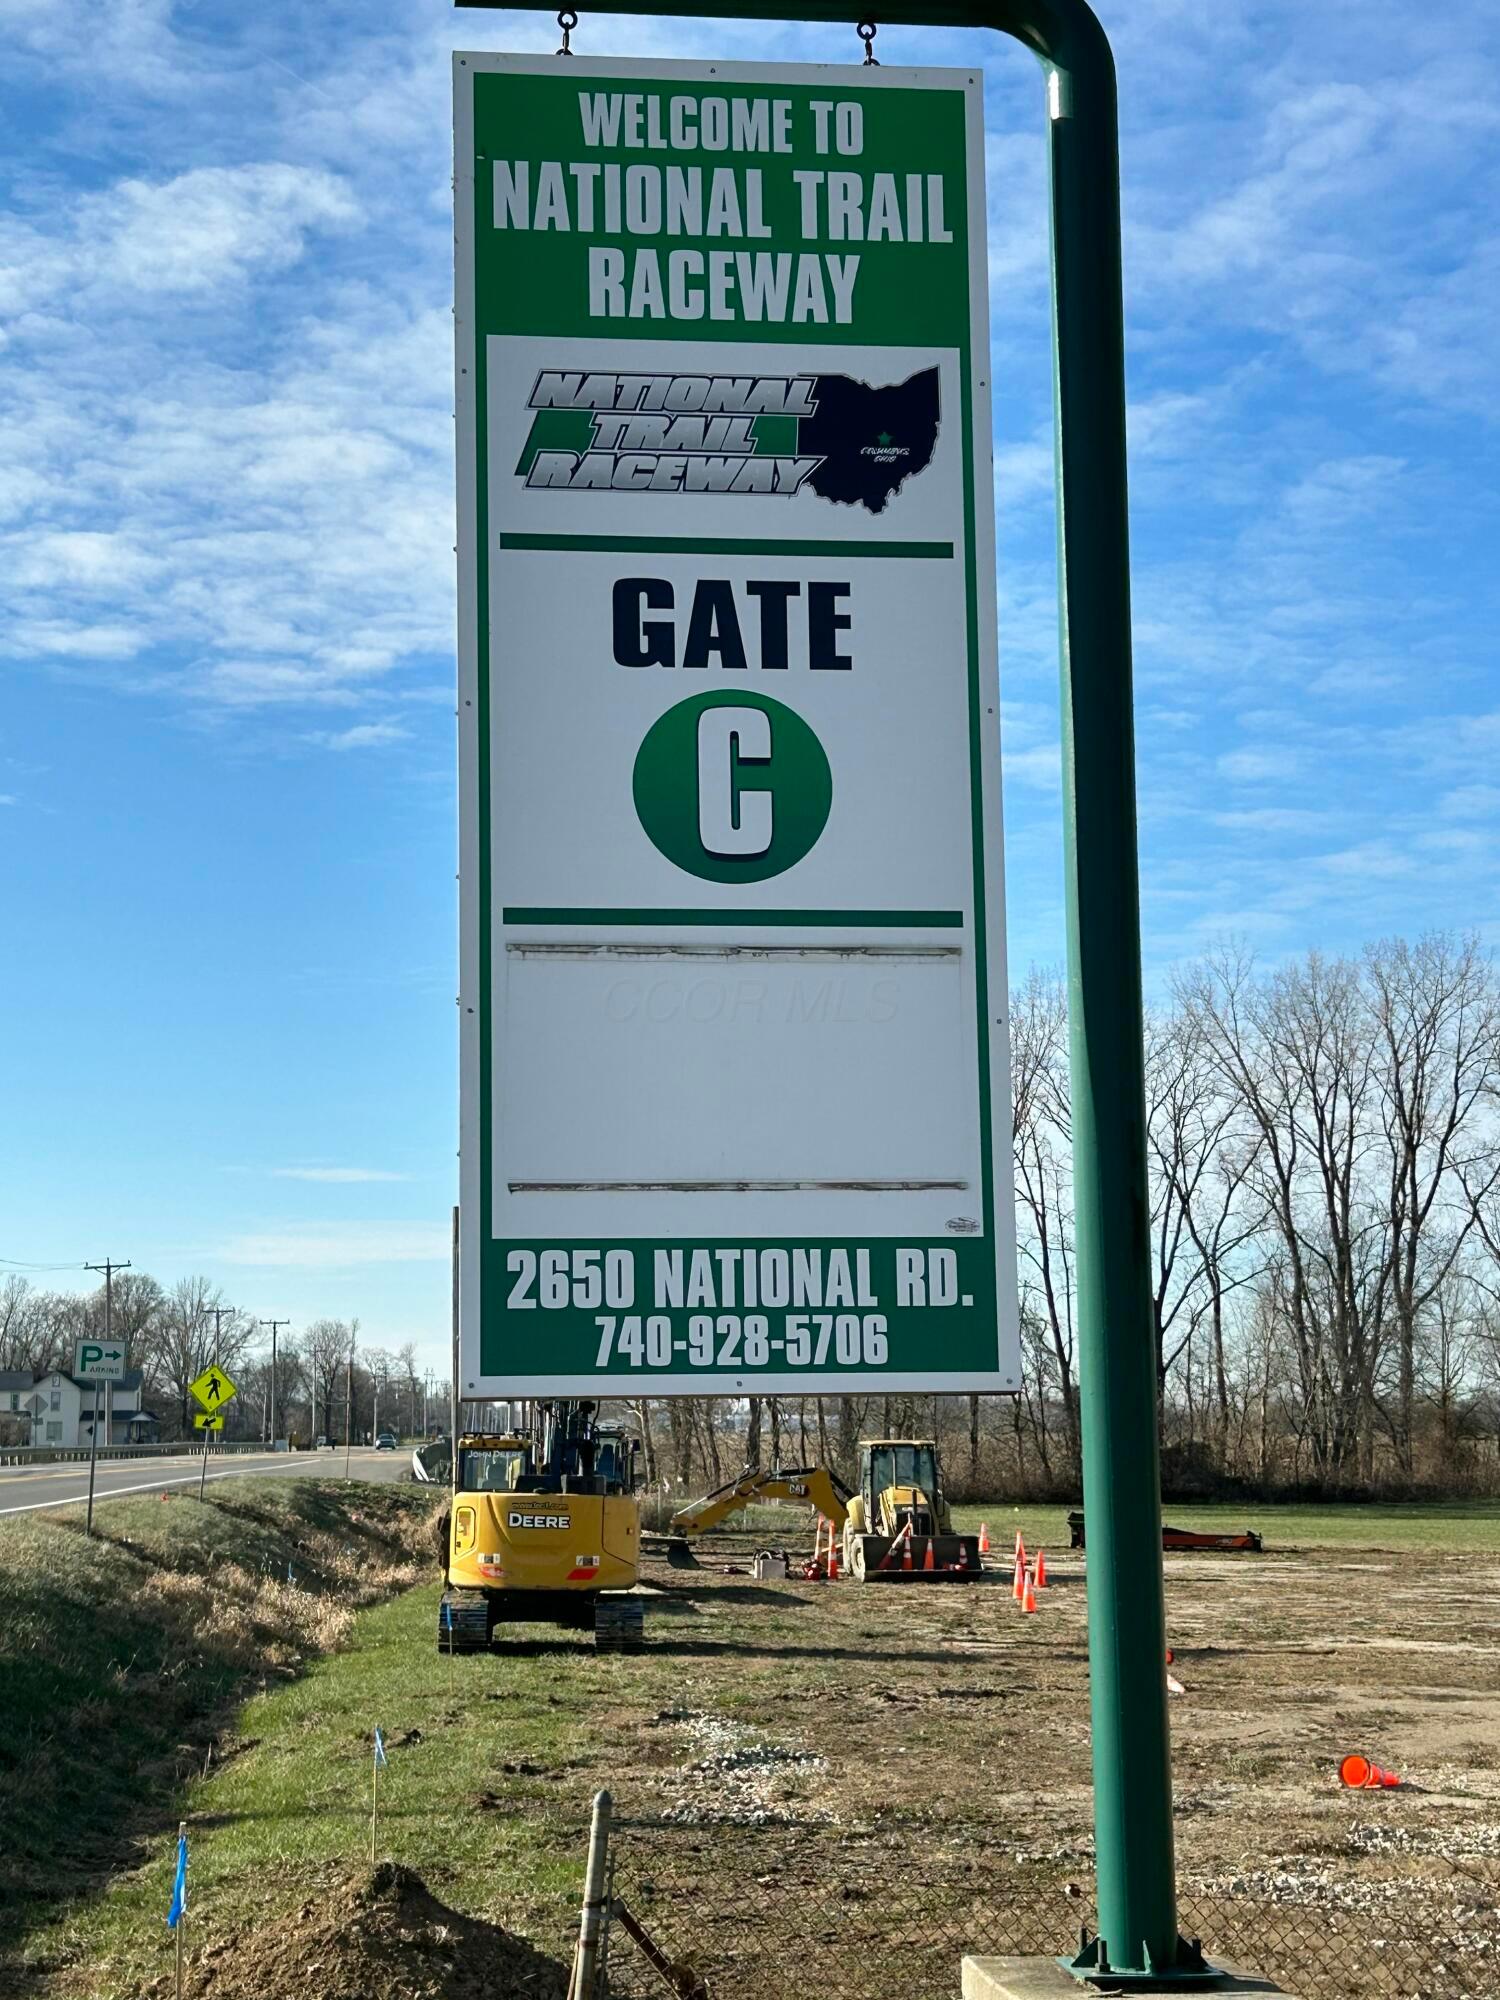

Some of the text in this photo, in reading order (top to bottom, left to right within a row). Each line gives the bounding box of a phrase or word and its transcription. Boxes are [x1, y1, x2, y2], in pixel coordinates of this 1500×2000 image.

[578, 92, 864, 156] WELCOME TO
[493, 160, 953, 244] NATIONAL TRAIL
[588, 246, 861, 324] RACEWAY
[528, 371, 818, 415] NATIONAL
[594, 412, 756, 453] TRAIL
[526, 452, 822, 495] RACEWAY
[612, 577, 853, 671] GATE
[697, 706, 774, 860] C
[506, 1248, 974, 1310] 2650 NATIONAL RD.
[595, 1314, 889, 1368] 740-928-5706
[509, 1512, 570, 1529] DEERE
